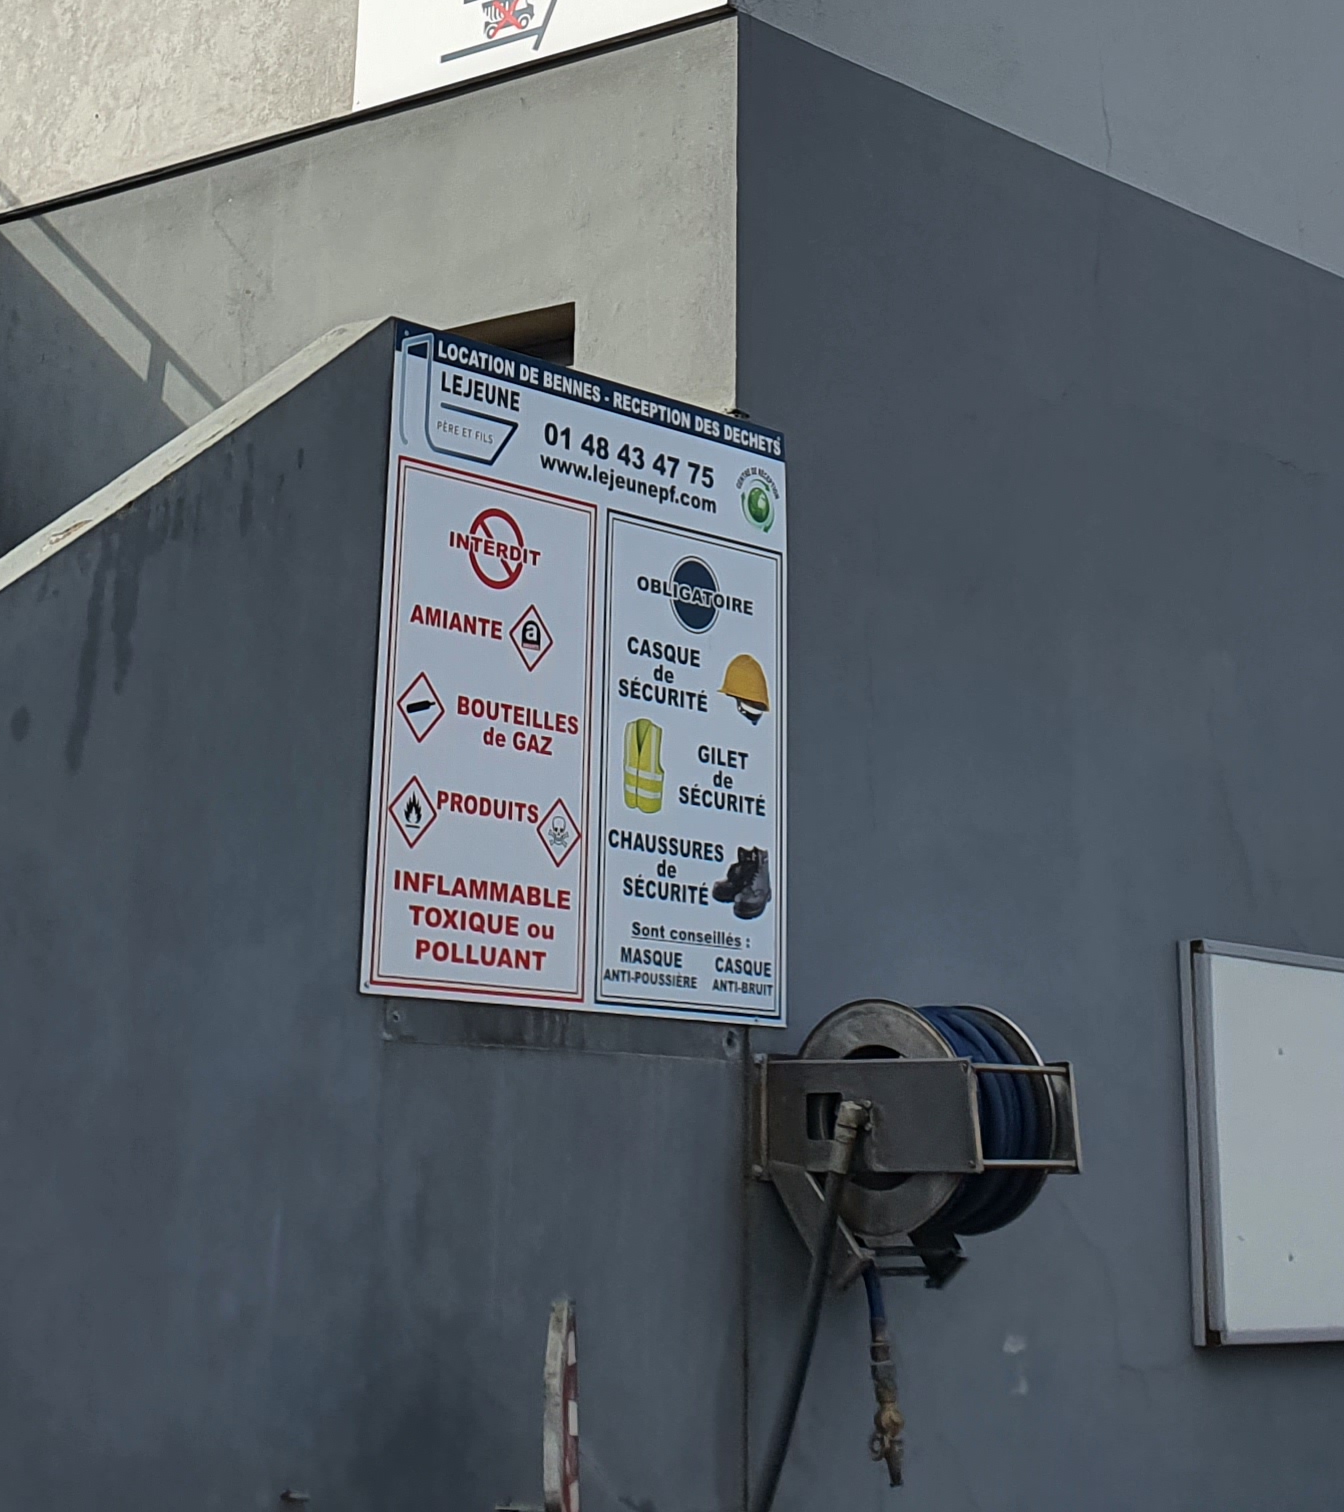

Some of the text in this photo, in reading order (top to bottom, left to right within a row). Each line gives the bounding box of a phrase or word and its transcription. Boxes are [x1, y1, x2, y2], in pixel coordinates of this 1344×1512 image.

[438, 340, 515, 378] LOCATION
[519, 364, 539, 385] DE
[543, 370, 601, 402] BENNES
[613, 391, 691, 430] RECEPTION
[695, 417, 720, 438] DES
[724, 424, 782, 456] DECHETS
[441, 371, 520, 412] LEJEUNE
[437, 420, 493, 445] PÈRE ET FILS
[544, 422, 714, 488] 01 48 43 47 75
[540, 453, 717, 514] www.lejeunepf.com
[449, 531, 541, 567] INTERDIT
[636, 575, 754, 616] OBLIGATOIRE
[411, 603, 503, 640] AMIANTE
[627, 636, 701, 668] CASQUE
[653, 665, 675, 684] de
[618, 677, 708, 714] SÉCURITÉ
[457, 695, 579, 736] BOUTEILLES
[483, 726, 553, 757] de GAZ
[698, 745, 749, 771] GILET
[713, 770, 734, 790] de
[437, 790, 540, 825] PRODUITS
[678, 785, 767, 818] SÉCURITÉ
[608, 828, 725, 863] CHAUSSURES
[657, 859, 677, 879] de
[394, 869, 572, 910] INFLAMMABLE
[622, 876, 710, 907] SÉCURITÉ
[409, 904, 555, 940] TOXIQUE ou
[632, 921, 665, 941] Sont
[669, 927, 742, 949] conseillés
[415, 939, 547, 972] POLLUANT
[620, 946, 683, 970] MASQUE
[715, 956, 772, 979] CASQUE
[603, 967, 698, 990] ANTI-POUSSIÈRE
[712, 978, 773, 998] ANTI-BRUIT
